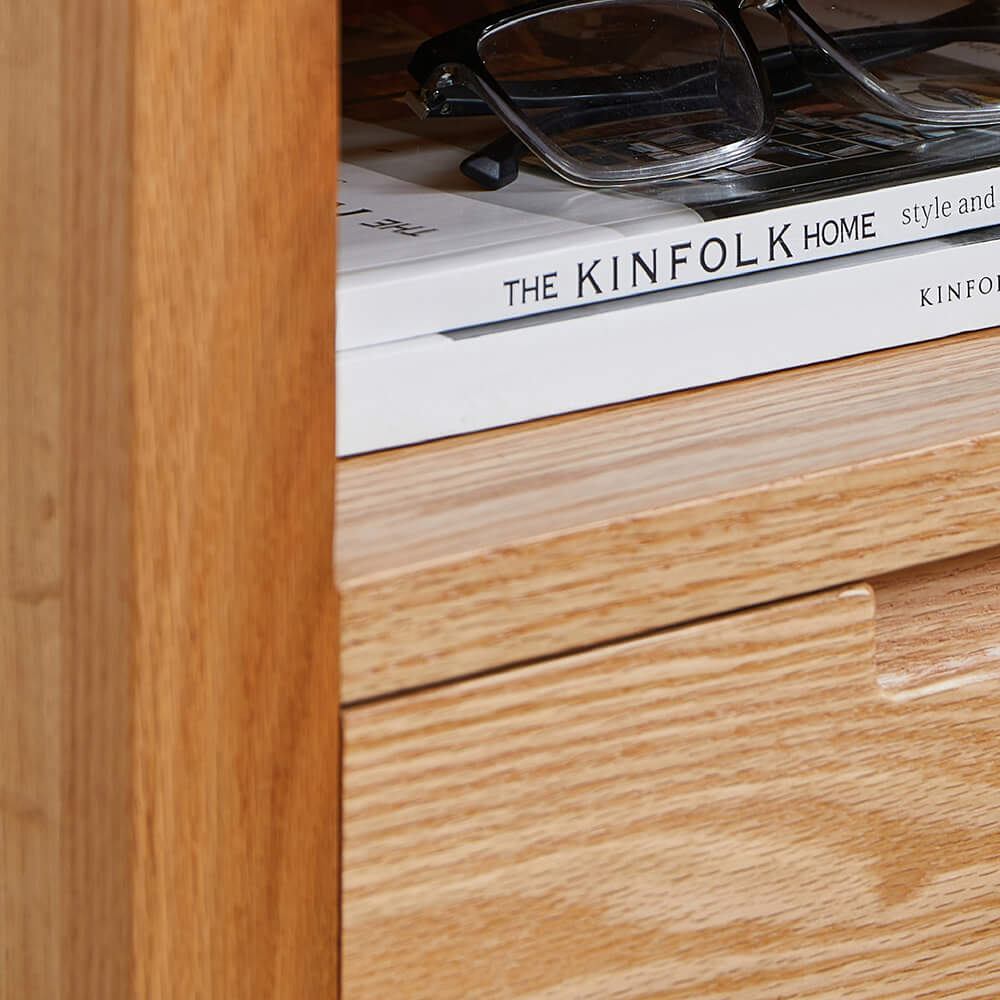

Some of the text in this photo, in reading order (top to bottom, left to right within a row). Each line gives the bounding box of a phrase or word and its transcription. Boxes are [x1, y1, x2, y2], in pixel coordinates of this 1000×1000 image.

[503, 271, 558, 307] THE
[577, 222, 794, 299] KINFOLK
[803, 211, 877, 250] HOME
[902, 195, 953, 229] style
[958, 185, 997, 216] and
